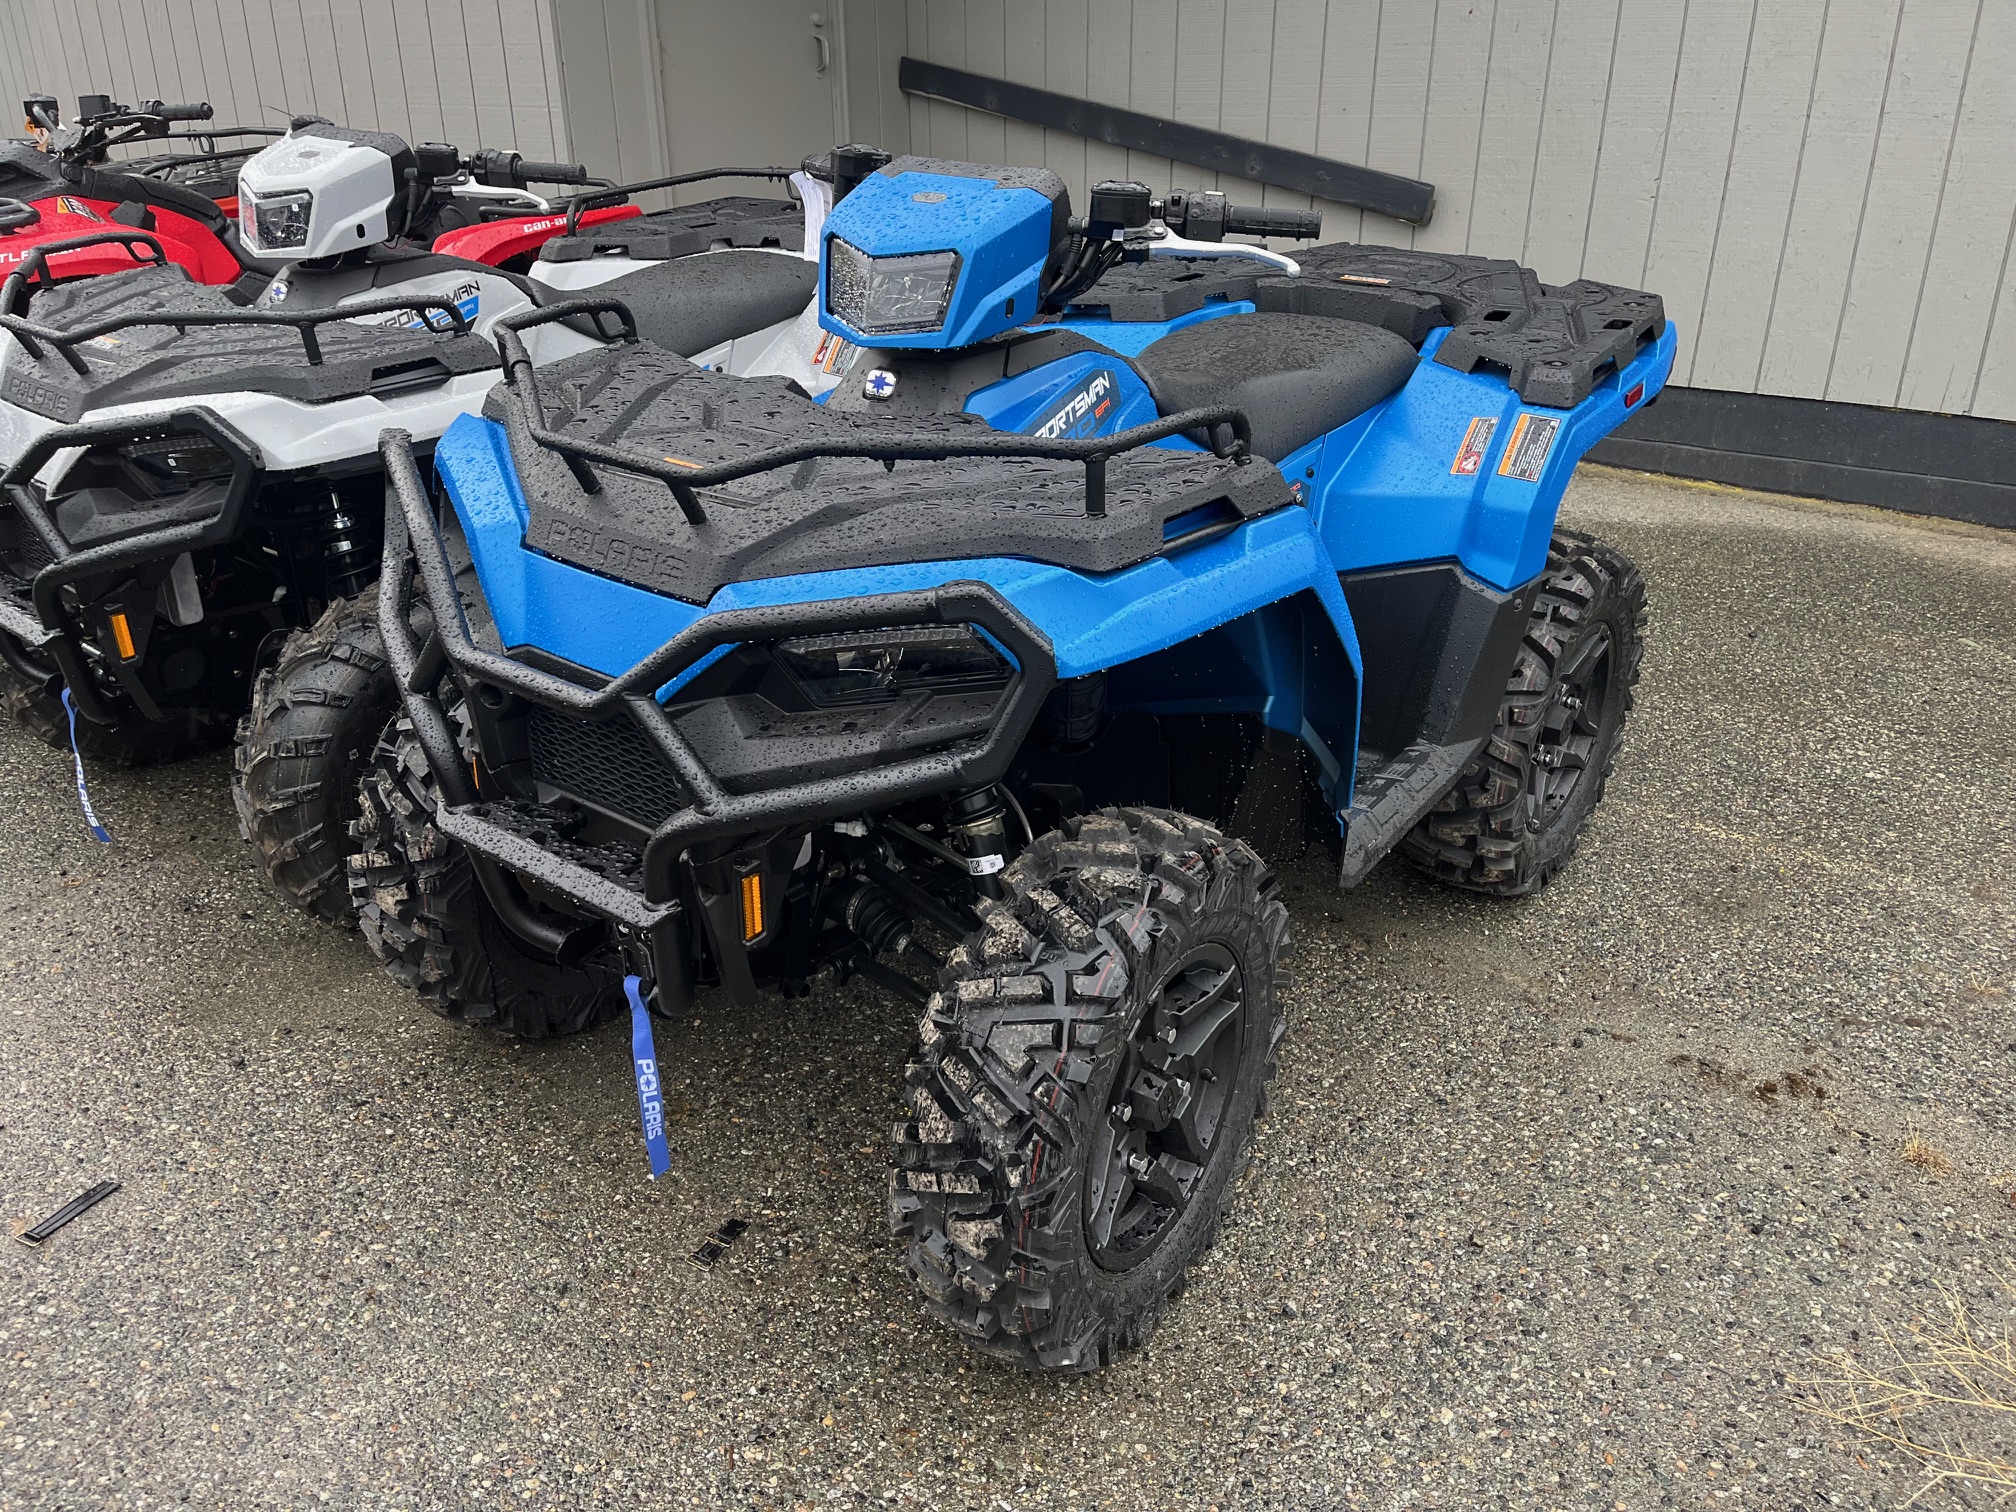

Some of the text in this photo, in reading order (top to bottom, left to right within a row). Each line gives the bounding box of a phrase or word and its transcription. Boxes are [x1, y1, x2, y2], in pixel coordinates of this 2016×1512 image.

[1033, 370, 1110, 438] PORTSMAN
[1508, 428, 1522, 456] WARNING
[547, 518, 689, 583] POLARIS
[637, 1058, 663, 1140] POLARIS
